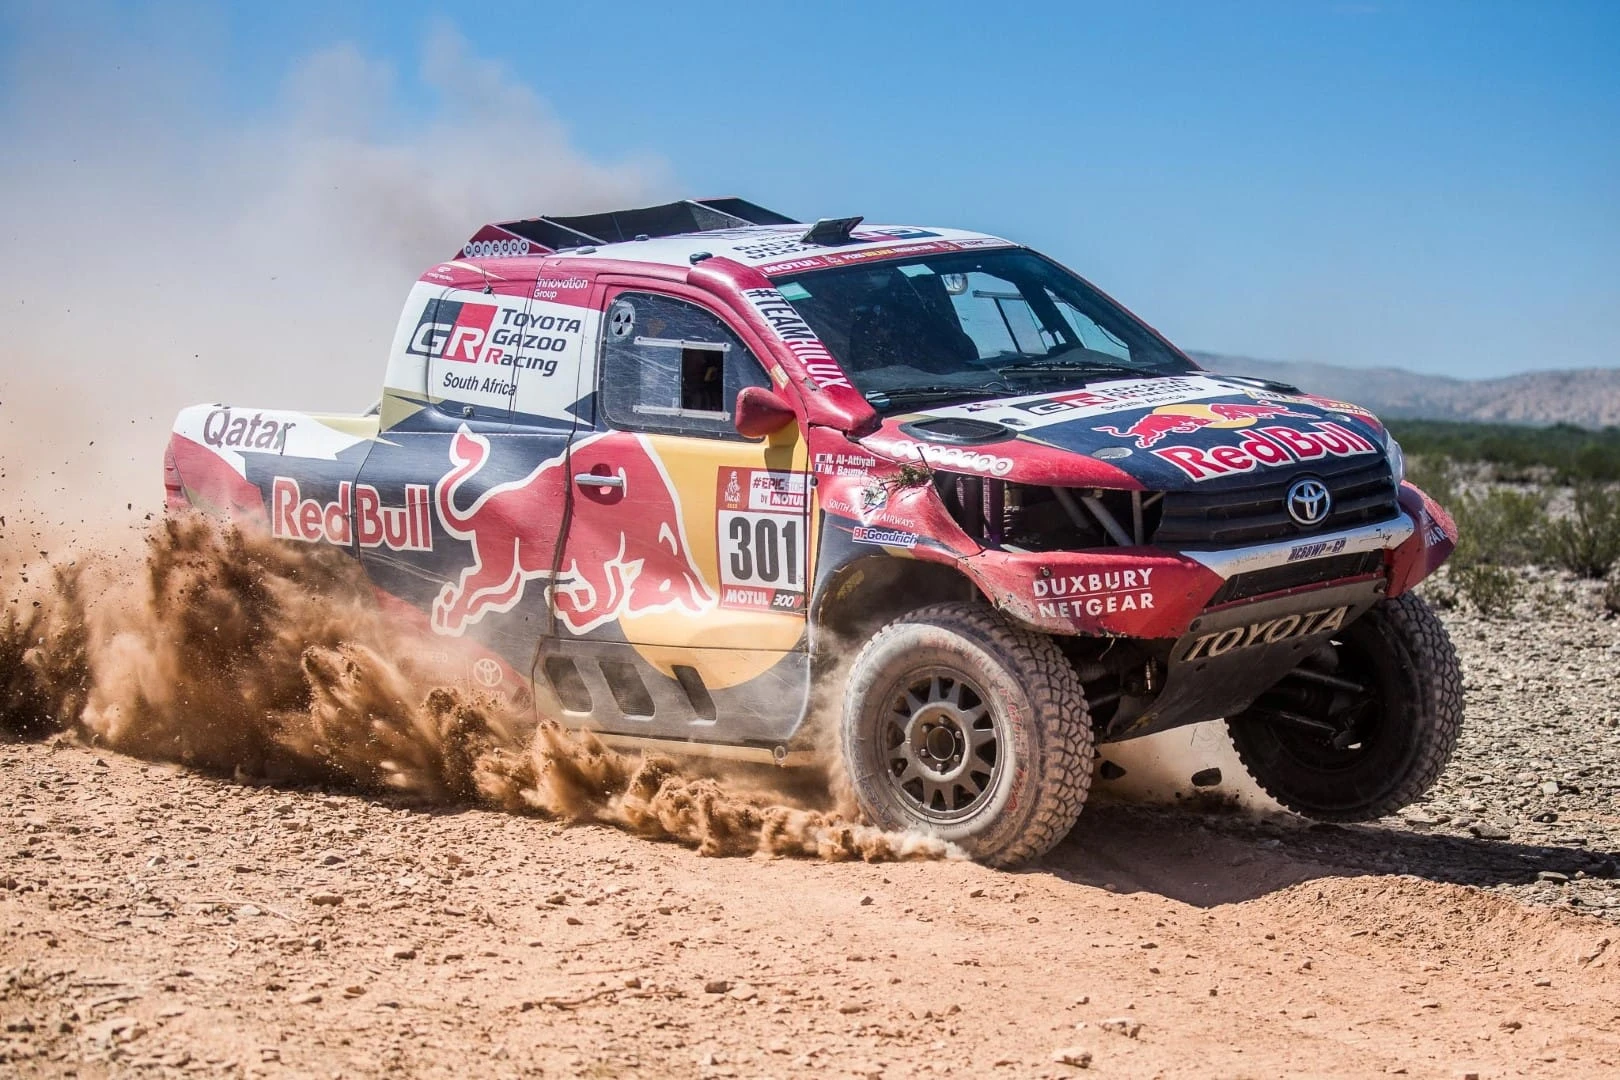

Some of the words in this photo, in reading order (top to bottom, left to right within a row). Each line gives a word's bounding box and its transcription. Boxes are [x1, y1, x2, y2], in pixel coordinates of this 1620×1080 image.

[464, 239, 529, 257] ooredoo
[763, 259, 820, 273] MOTUL
[534, 289, 557, 300] Group
[502, 308, 582, 334] TOYOTA
[410, 321, 487, 361] GR
[492, 329, 567, 352] GAZOO
[746, 289, 853, 389] #TEAMHILUX
[484, 348, 558, 377] Racing
[443, 372, 478, 391] South
[481, 377, 518, 396] Africa
[1028, 397, 1117, 415] GR
[203, 409, 296, 449] Qatar
[826, 453, 834, 464] N.
[836, 454, 875, 468] Al-Attiyah
[1150, 429, 1295, 483] Red
[1259, 421, 1377, 462] Bull
[824, 464, 834, 475] M.
[760, 493, 769, 504] by
[272, 476, 352, 546] Red
[355, 483, 433, 552] Bull
[828, 499, 849, 511] SOUTH
[879, 513, 914, 528] AIRWAYS
[854, 528, 918, 545] BFGoodrich
[729, 516, 797, 585] 301
[1033, 568, 1153, 597] DUXBURY
[726, 589, 769, 606] MOTUL
[773, 593, 804, 608] 300V
[1038, 593, 1154, 618] NETGEAR
[1179, 605, 1353, 662] TOYOTA
